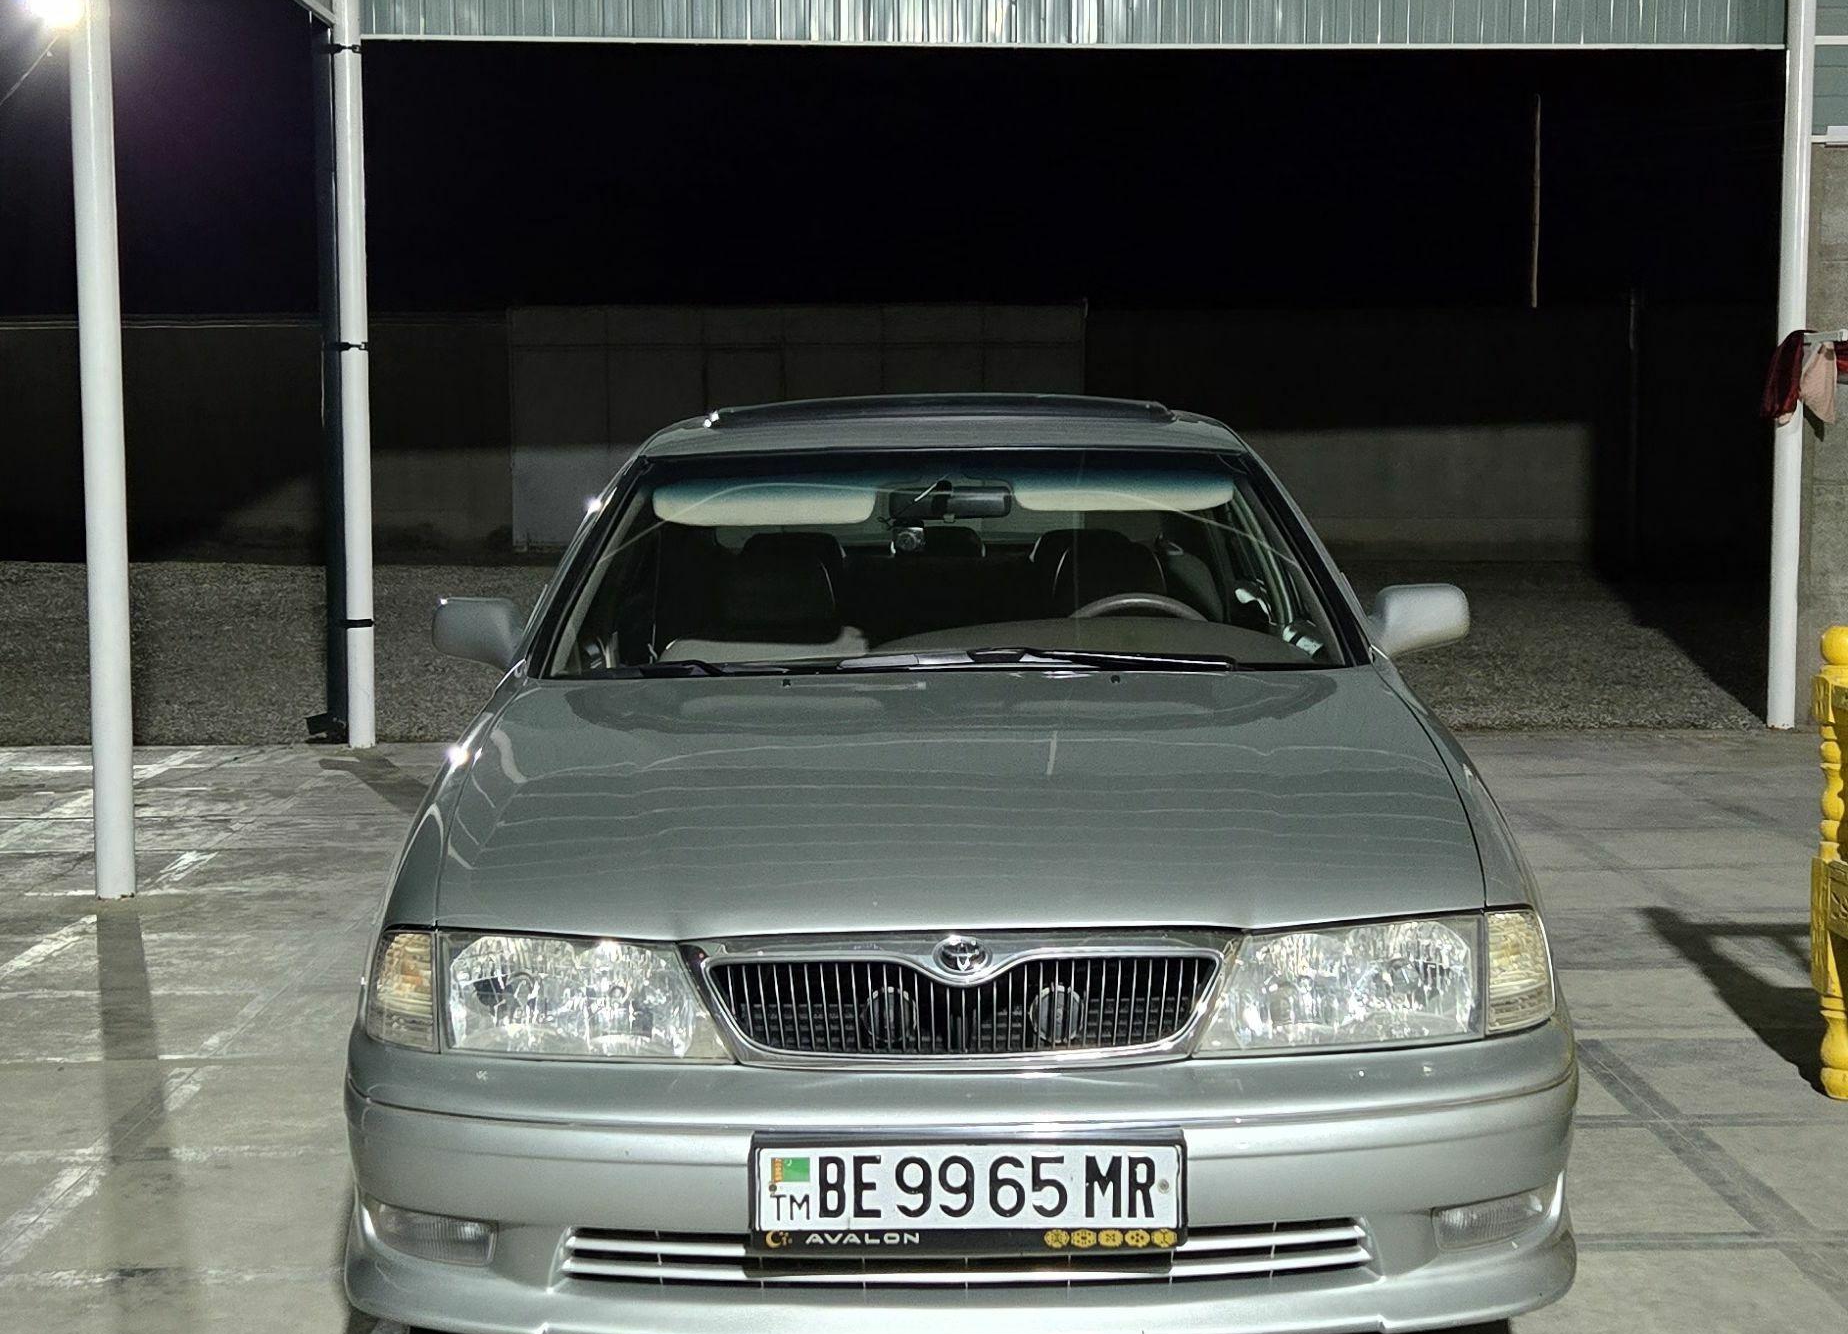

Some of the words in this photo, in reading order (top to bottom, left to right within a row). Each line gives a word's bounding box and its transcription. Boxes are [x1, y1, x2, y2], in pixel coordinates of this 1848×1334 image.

[818, 1154, 882, 1219] BE
[1084, 1155, 1156, 1219] MR
[771, 1194, 811, 1221] TM
[804, 1232, 921, 1246] AVALON
